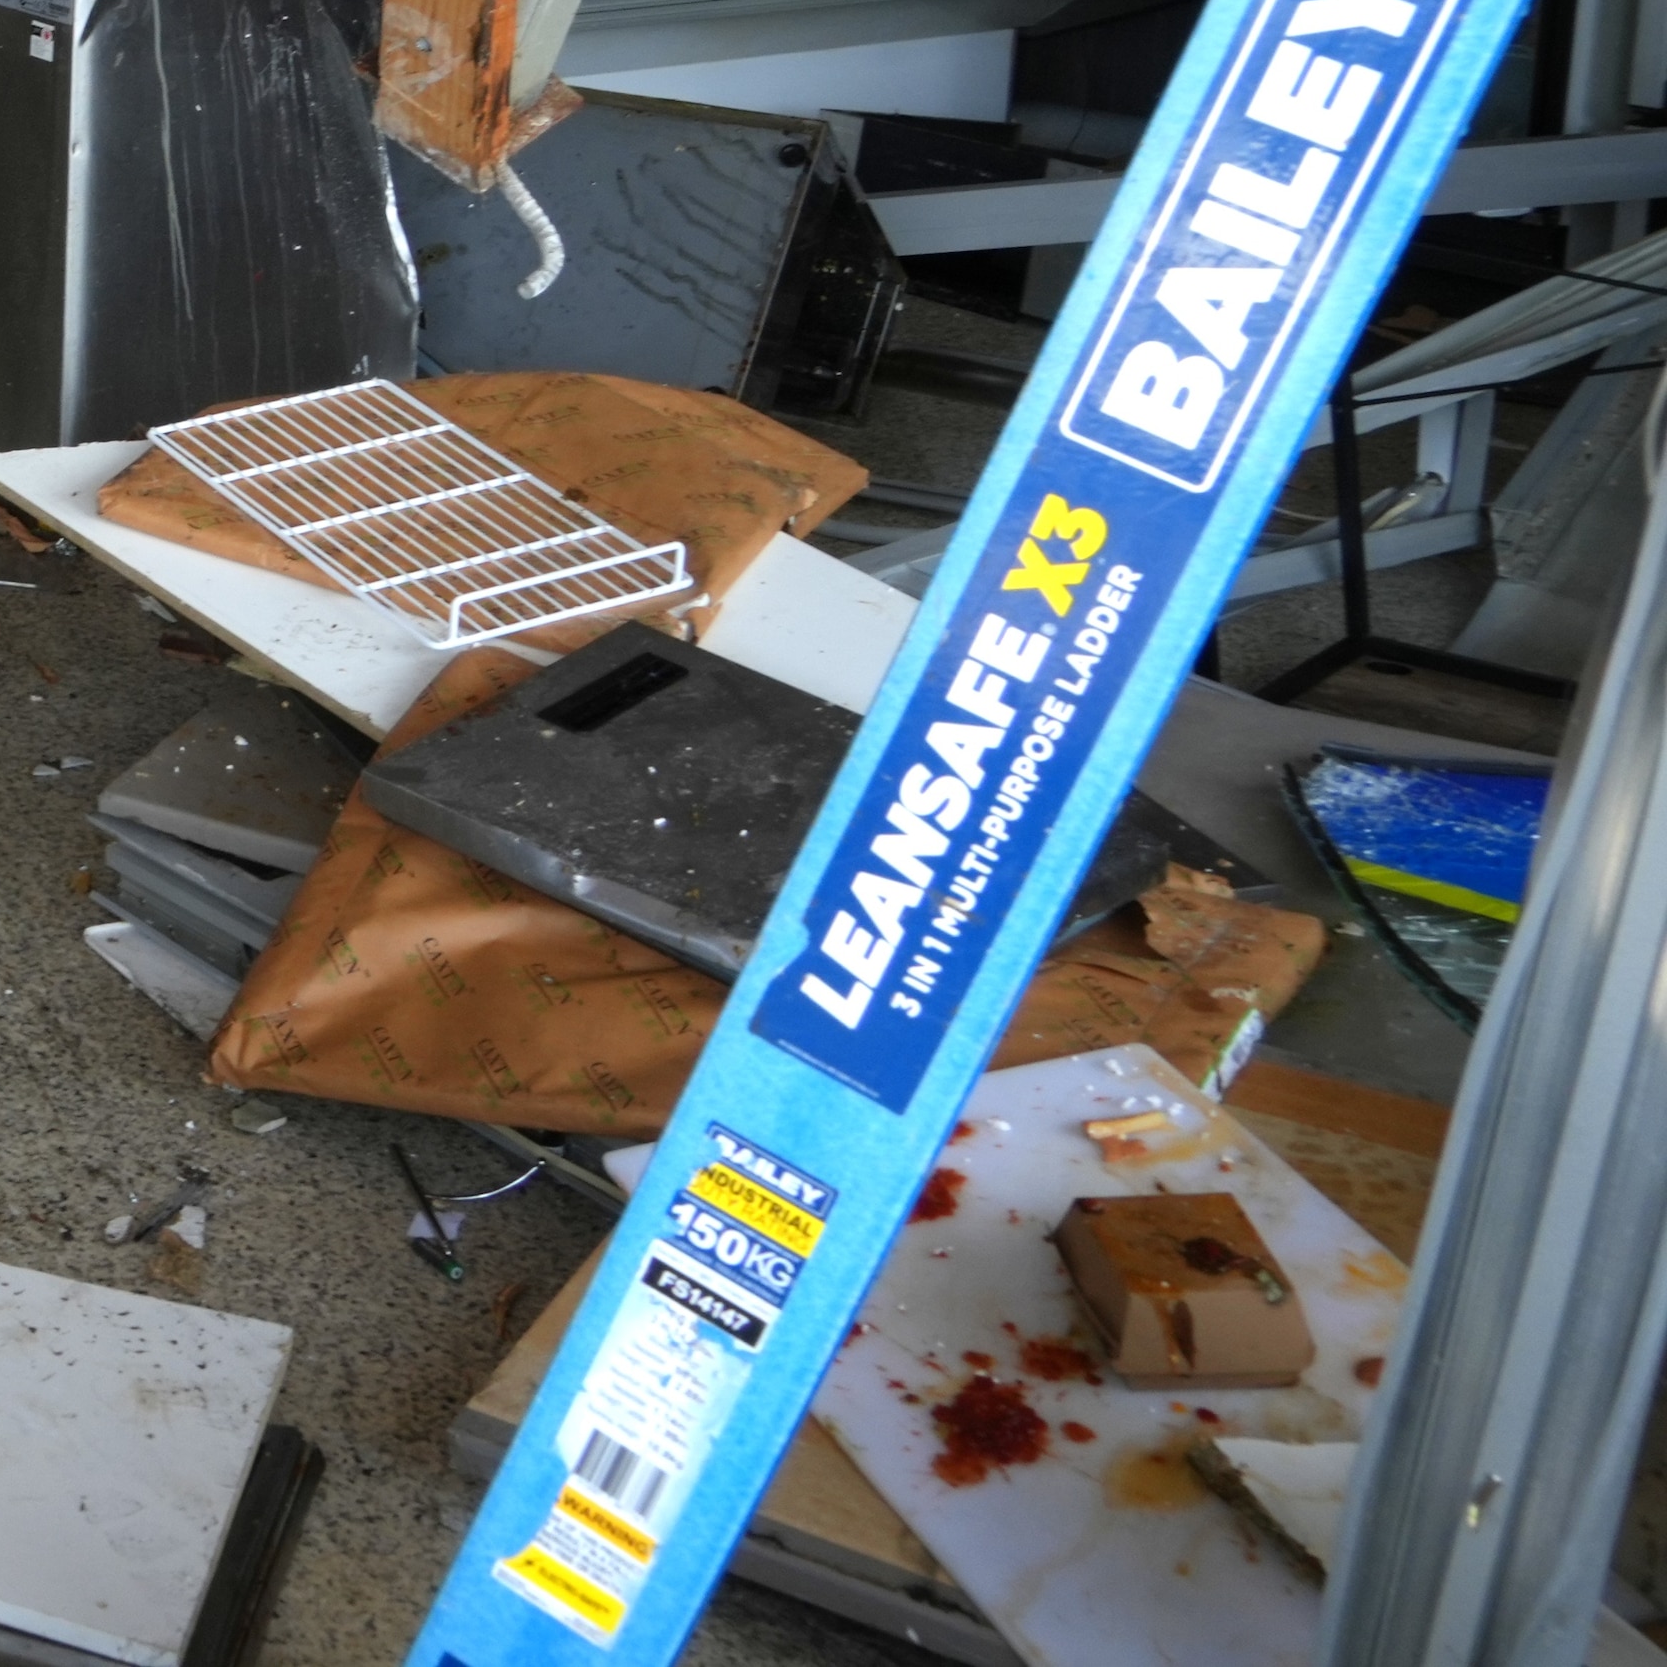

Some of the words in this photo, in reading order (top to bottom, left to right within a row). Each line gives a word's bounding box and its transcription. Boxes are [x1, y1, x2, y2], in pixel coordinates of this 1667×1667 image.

[1068, 563, 1144, 697] LADDER
[800, 613, 1051, 1030] LEANSAFE
[1002, 493, 1108, 617] X3
[932, 695, 1076, 939] MULTI-PURPOSE
[903, 953, 944, 996] IN
[923, 937, 953, 956] 1
[890, 990, 922, 1019] 3
[672, 1202, 795, 1288] 150KG
[658, 1270, 751, 1331] FS14147
[564, 1495, 648, 1554] WARNING
